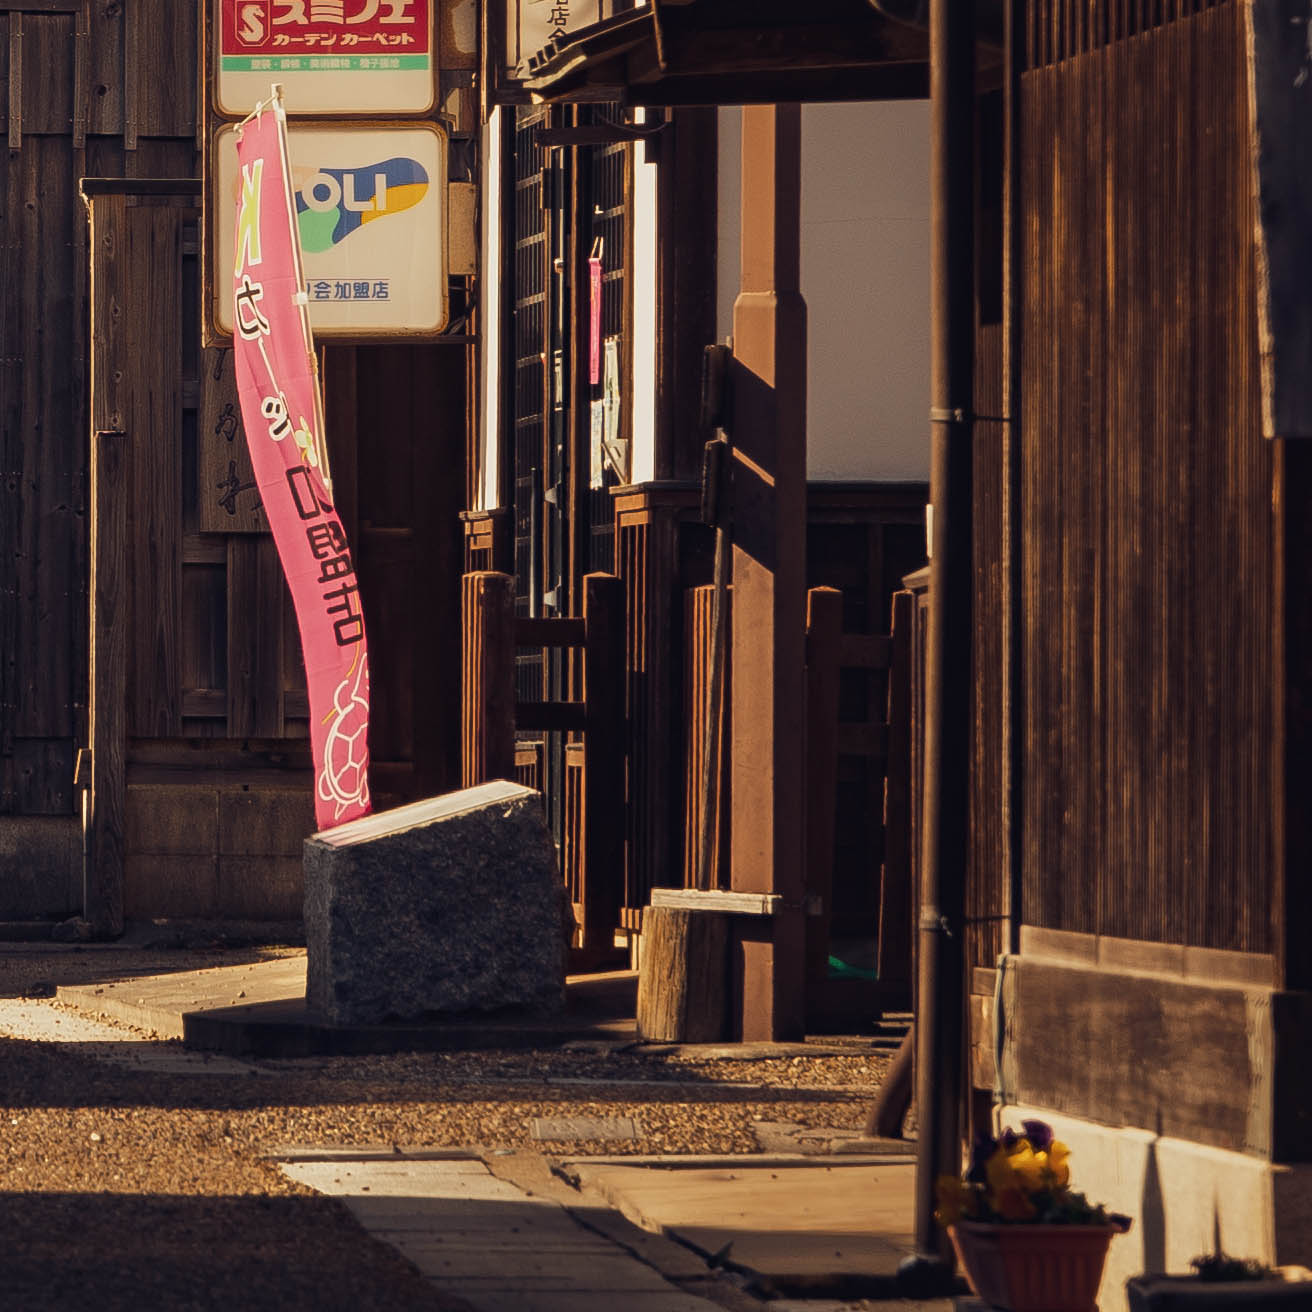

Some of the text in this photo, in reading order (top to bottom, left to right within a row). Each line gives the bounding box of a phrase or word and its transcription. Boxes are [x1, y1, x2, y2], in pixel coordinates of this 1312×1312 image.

[272, 32, 416, 46] カーテン カーペット
[290, 172, 387, 213] OLI
